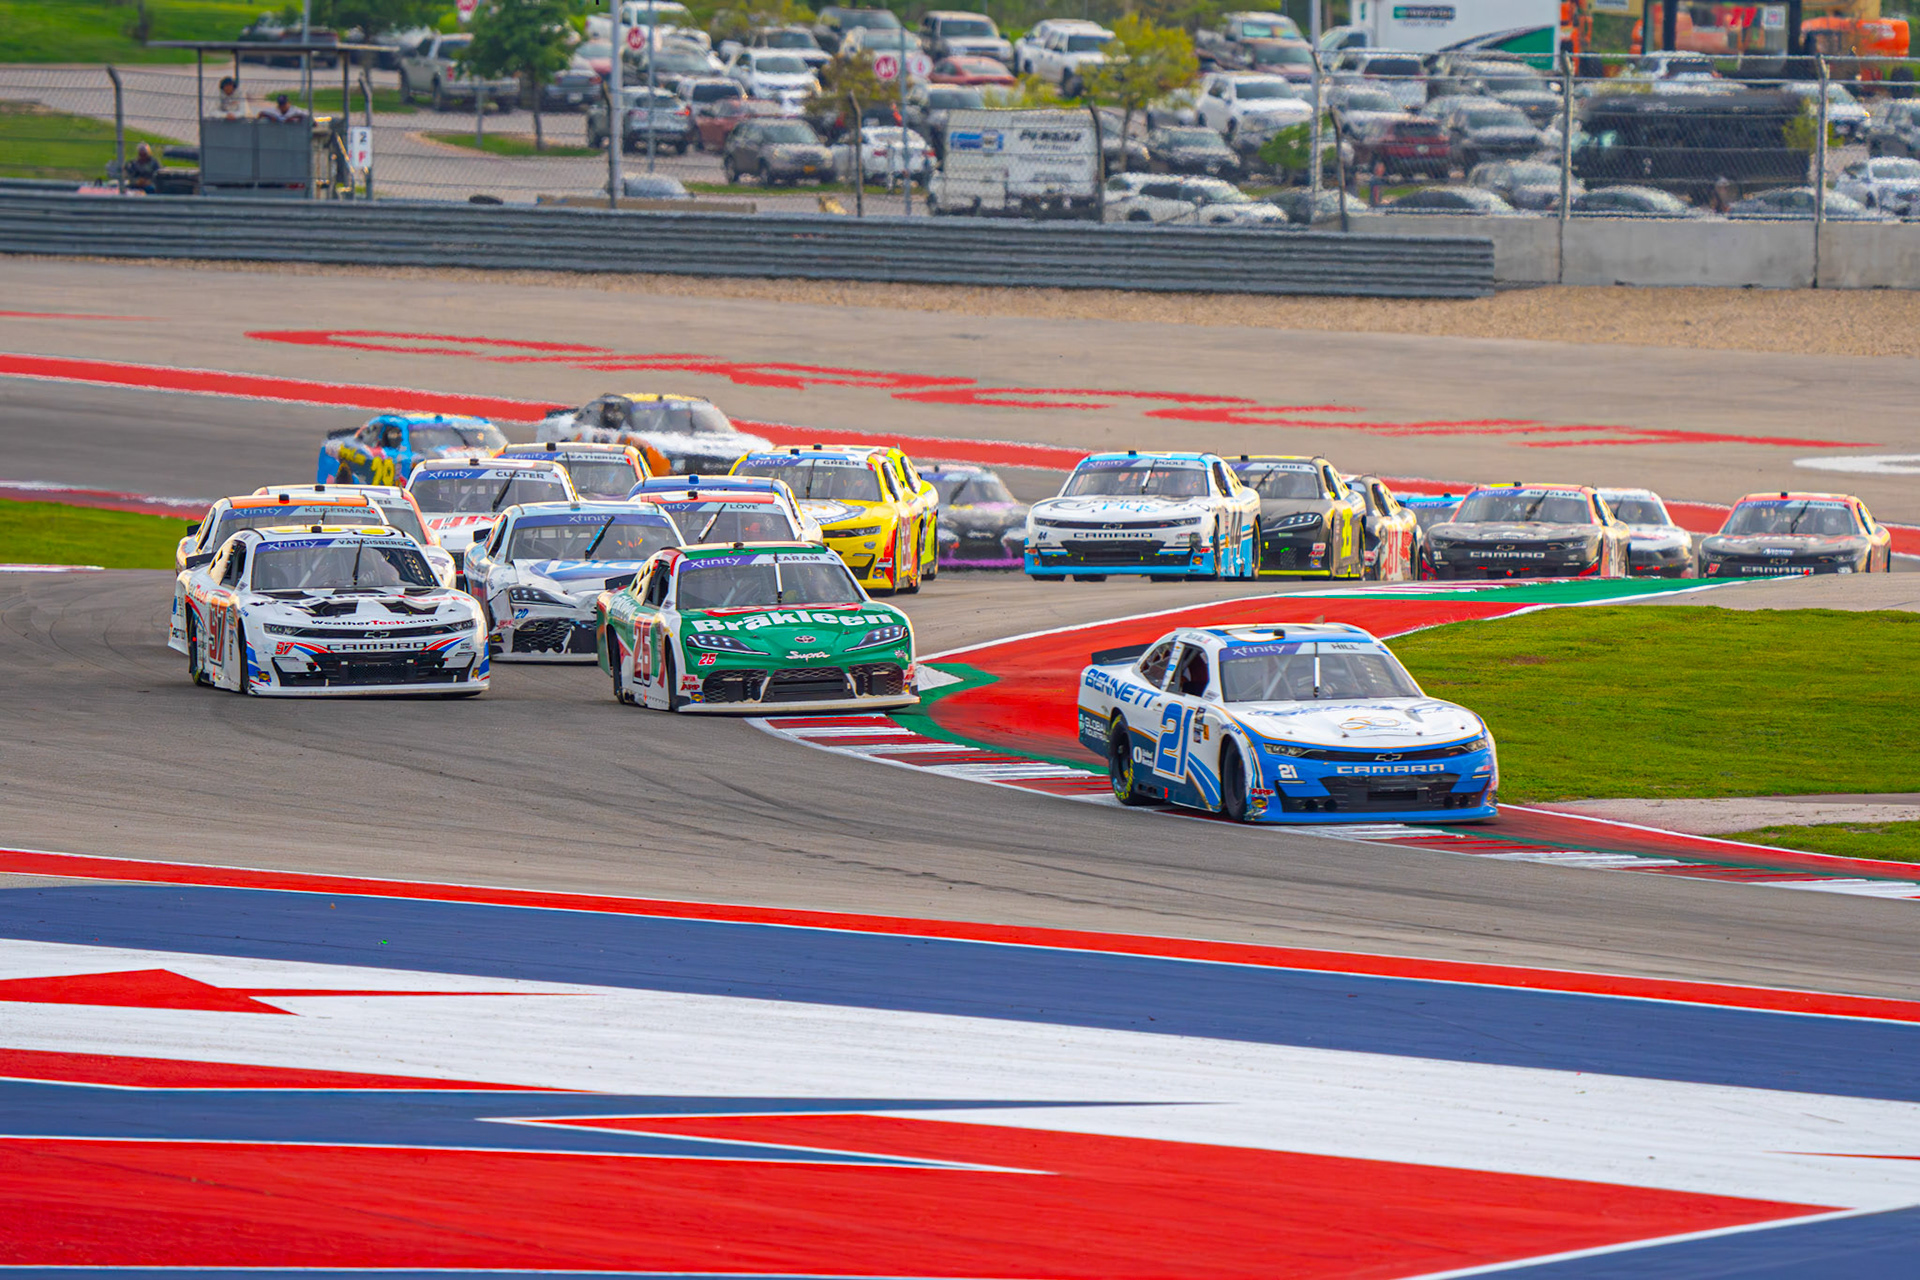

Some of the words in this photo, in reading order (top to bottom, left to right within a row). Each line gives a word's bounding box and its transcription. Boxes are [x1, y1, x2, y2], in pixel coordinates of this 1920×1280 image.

[748, 458, 790, 468] xfinity
[822, 459, 861, 467] GREEN
[1087, 460, 1126, 469] xfinity
[428, 470, 473, 480] xfinity
[495, 471, 545, 480] CUSTER
[1529, 490, 1579, 498] REZLAFF
[304, 506, 371, 515] KLIGERMAN
[663, 502, 691, 511] nity
[233, 507, 282, 517] xfinity
[1037, 531, 1048, 541] 44
[268, 539, 318, 551] xfinity
[363, 539, 409, 547] GISBERGE
[773, 553, 822, 563] KARAM
[1470, 551, 1545, 559] CAMARO
[690, 555, 742, 569] xfinity
[514, 607, 529, 620] 20
[310, 616, 439, 627] WeatherTech.com
[691, 611, 895, 633] Brakleen
[275, 641, 296, 656] 97
[326, 641, 428, 651] CAMARO
[1232, 644, 1286, 656] xfinity
[1331, 642, 1359, 651] HILL
[698, 653, 719, 667] 26
[785, 650, 831, 663] Supra
[1084, 668, 1162, 709] BENNETT
[1154, 701, 1196, 783] 21
[1277, 763, 1299, 779] 21
[1337, 763, 1445, 774] CAMARO
